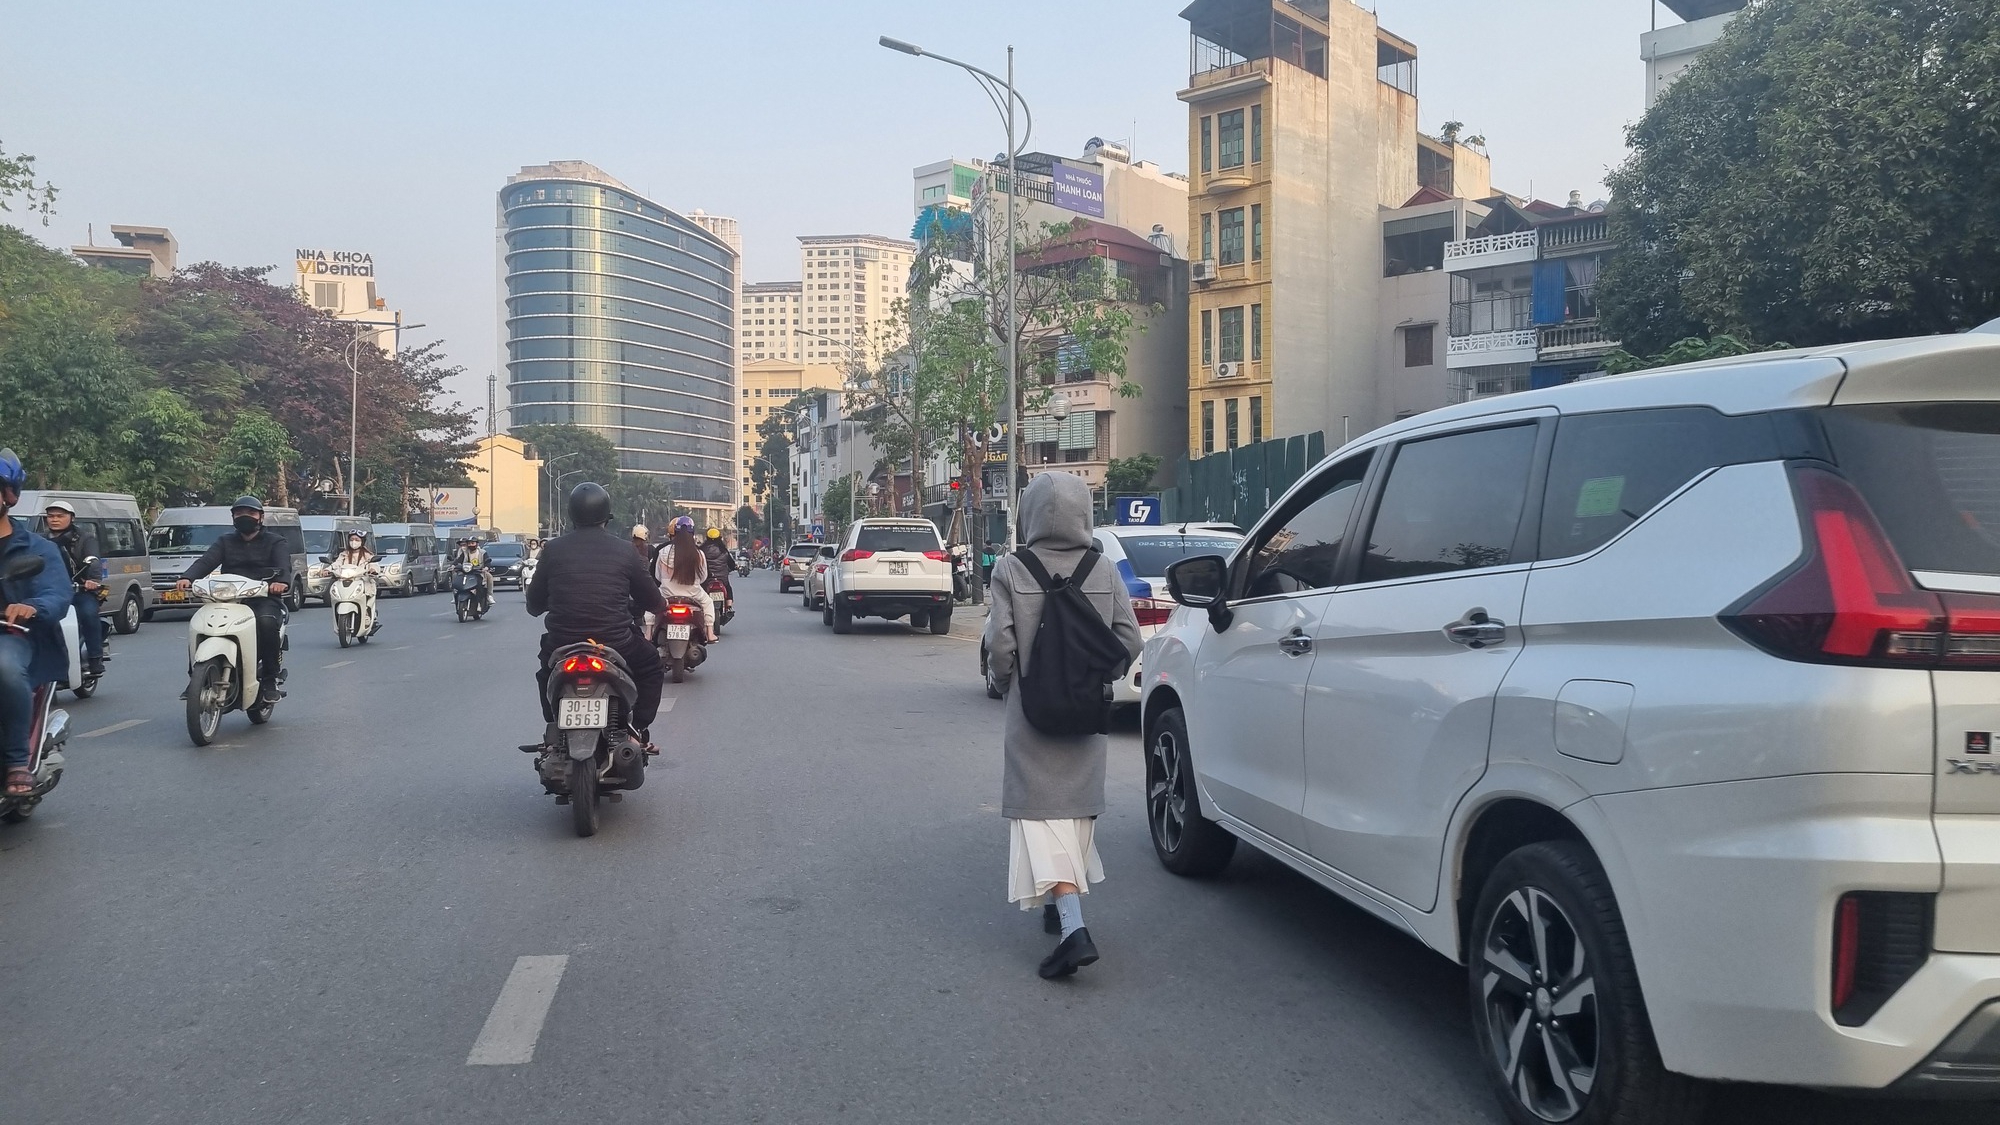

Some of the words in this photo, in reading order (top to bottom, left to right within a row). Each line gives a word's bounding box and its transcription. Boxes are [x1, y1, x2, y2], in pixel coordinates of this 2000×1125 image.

[1055, 181, 1081, 197] THANH
[1082, 189, 1103, 202] LOAN
[296, 248, 326, 260] NHA
[333, 250, 373, 263] KHOA
[1129, 500, 1151, 523] G7
[566, 700, 601, 712] 30-L9
[565, 713, 600, 726] 6563
